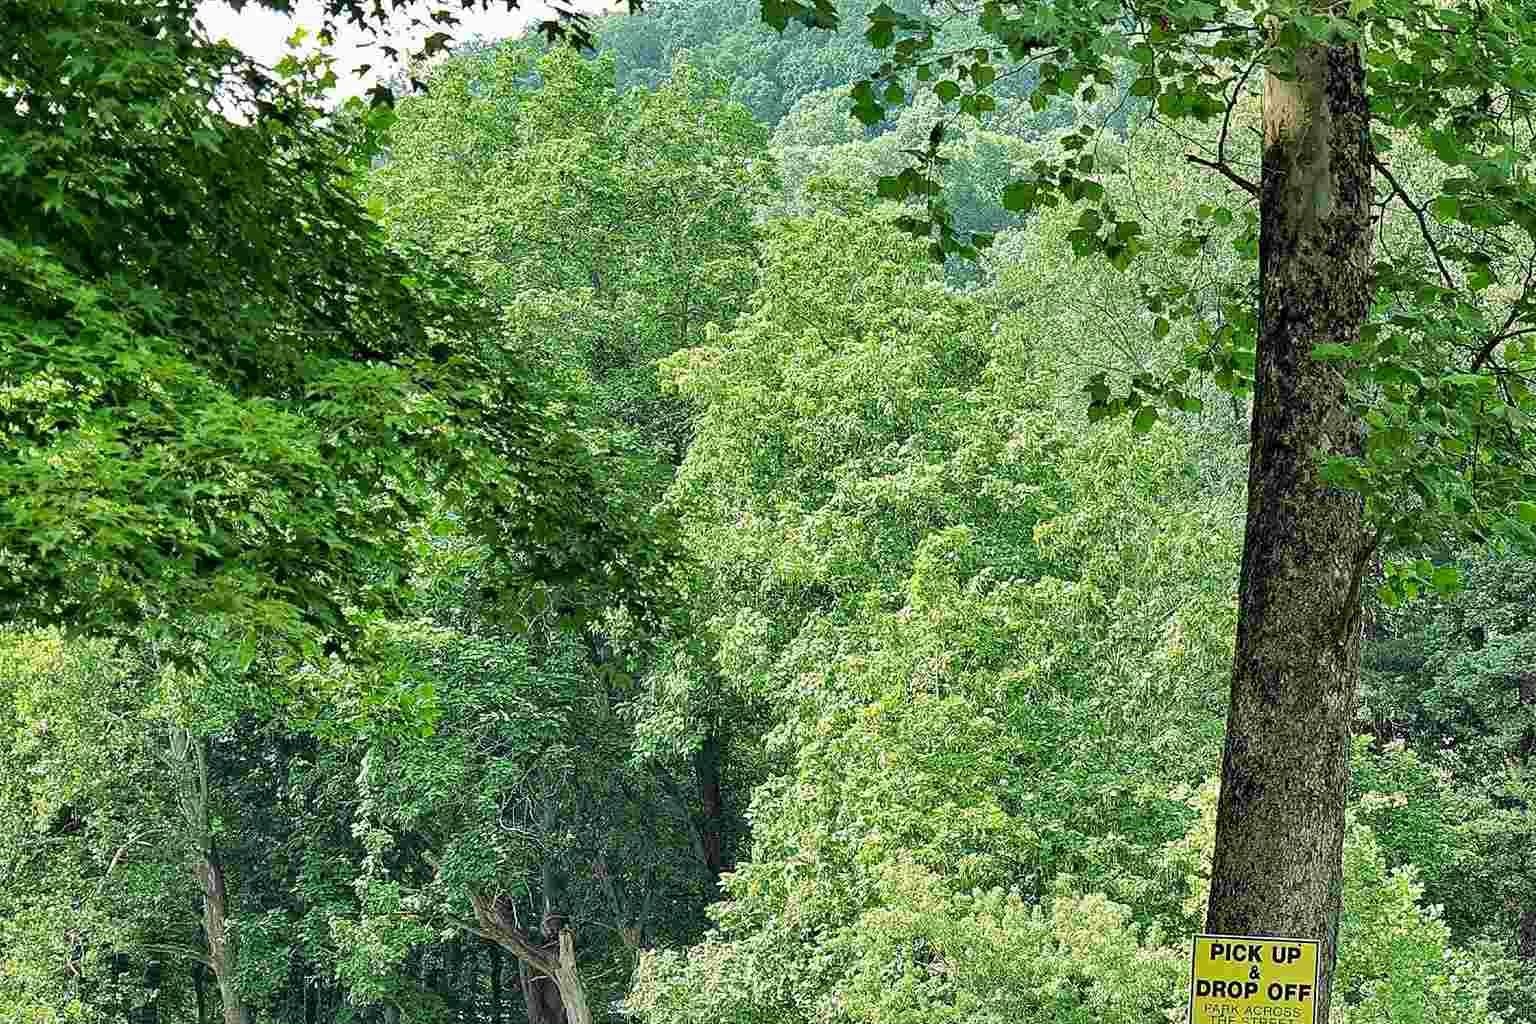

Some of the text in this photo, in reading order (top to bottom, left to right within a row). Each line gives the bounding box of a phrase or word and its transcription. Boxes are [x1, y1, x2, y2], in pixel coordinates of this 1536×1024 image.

[1210, 943, 1301, 964] PICK UP
[1249, 965, 1260, 980] &
[1196, 980, 1312, 1002] DROP OFF
[1204, 1003, 1301, 1018] PARK ACROSS
